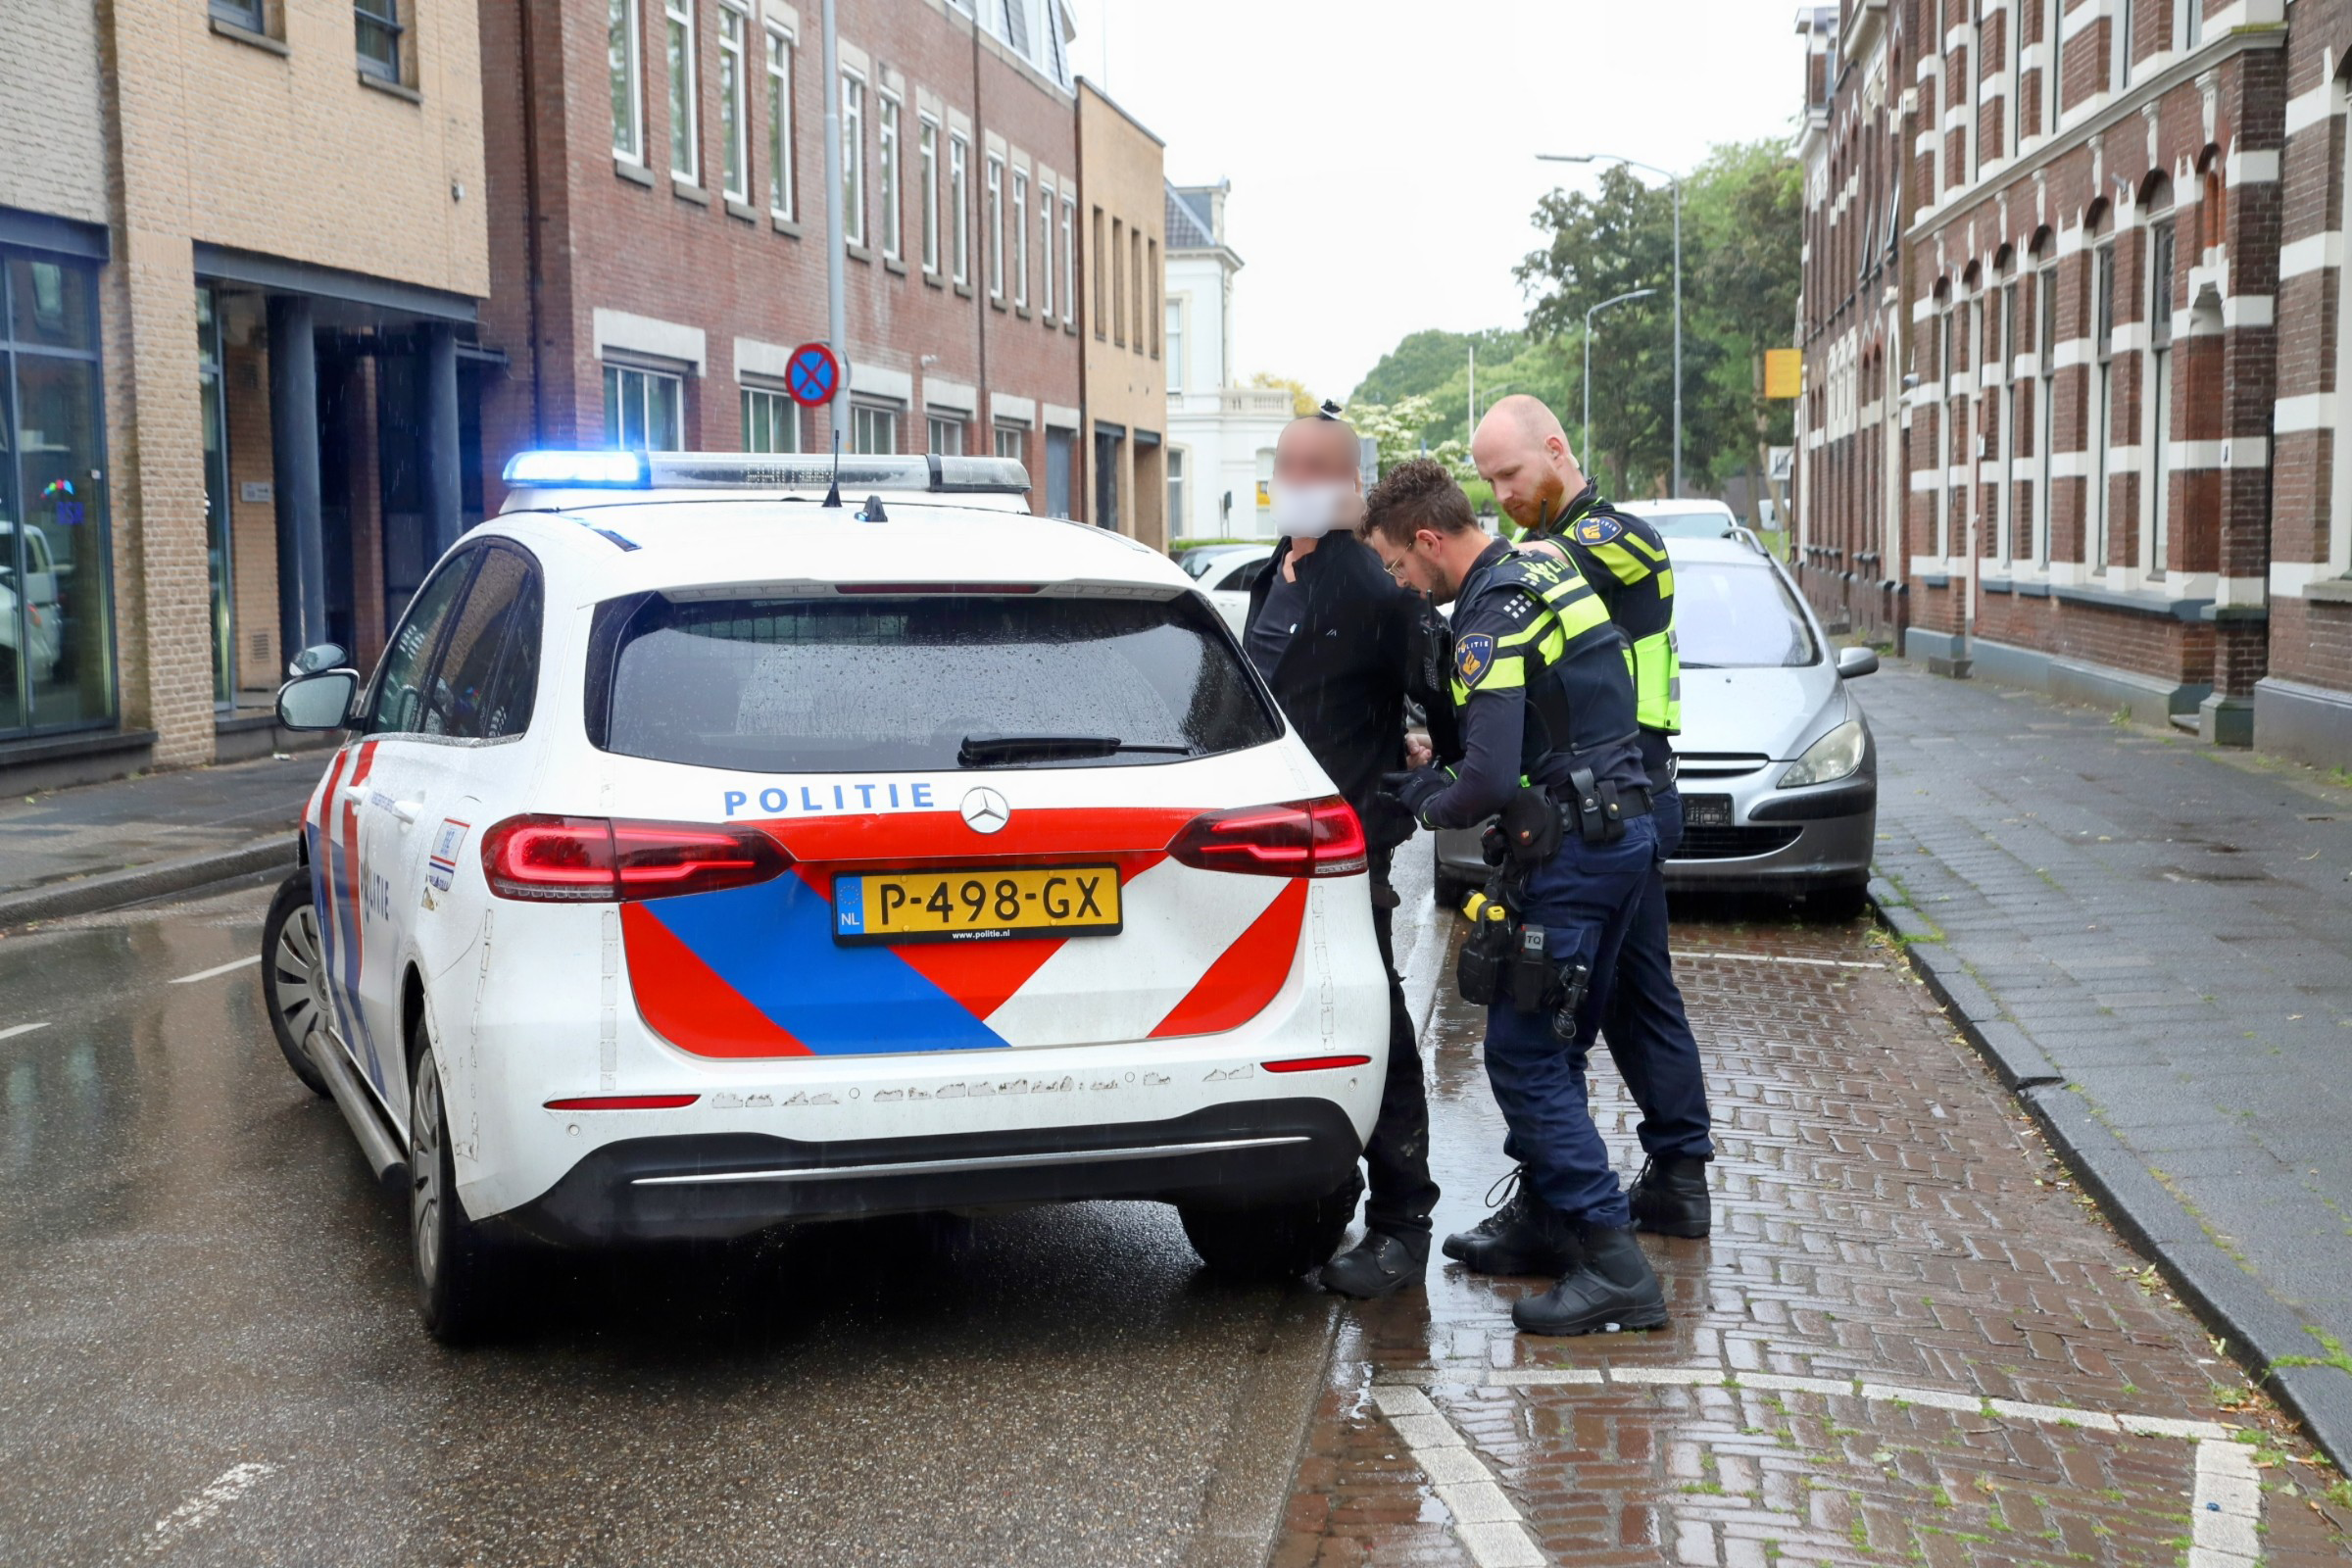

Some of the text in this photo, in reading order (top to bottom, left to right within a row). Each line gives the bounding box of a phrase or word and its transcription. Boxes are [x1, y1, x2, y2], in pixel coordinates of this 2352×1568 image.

[724, 783, 934, 815] POLITIE
[880, 876, 1102, 925] P-498-GX
[841, 912, 859, 926] NL
[952, 929, 1010, 940] www.politie.nl
